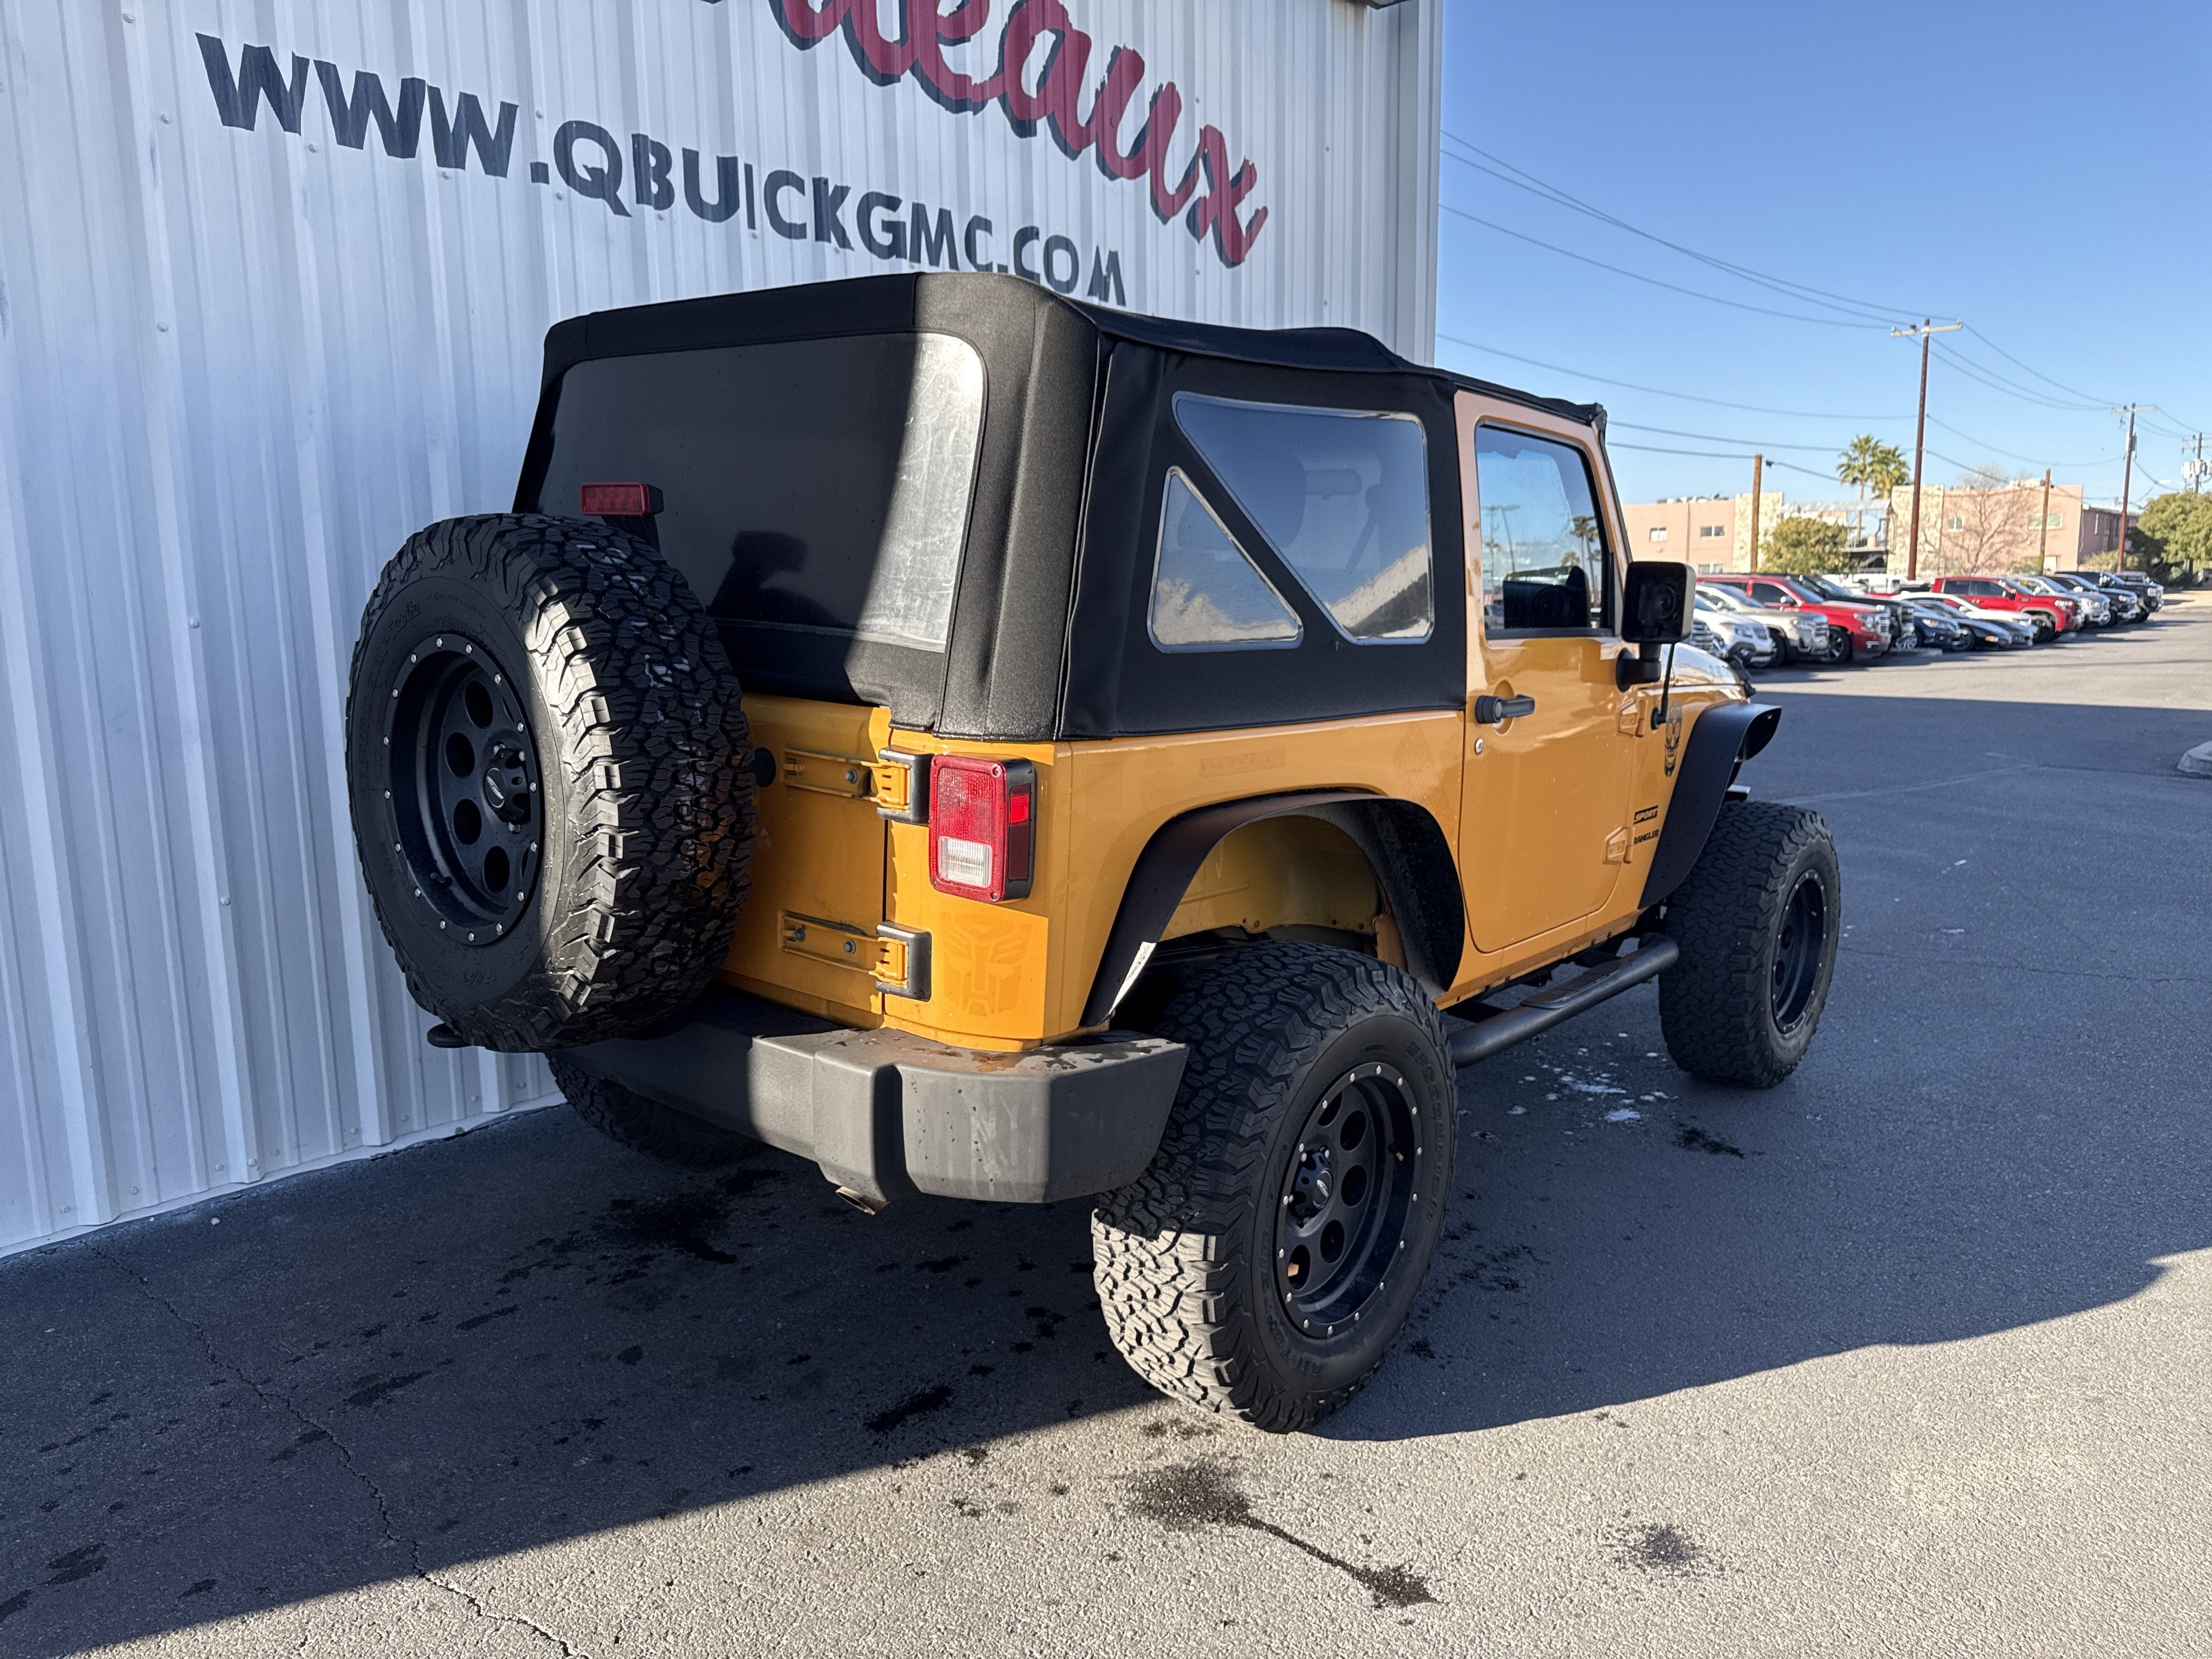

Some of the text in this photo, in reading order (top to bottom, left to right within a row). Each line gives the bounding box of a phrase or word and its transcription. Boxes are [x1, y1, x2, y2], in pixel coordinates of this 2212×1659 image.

[195, 32, 1126, 307] WWW.QBUICKGMC.COM
[769, 0, 1268, 269] eaux
[1634, 829, 1659, 844] RANGLER
[1635, 808, 1657, 821] SPORT
